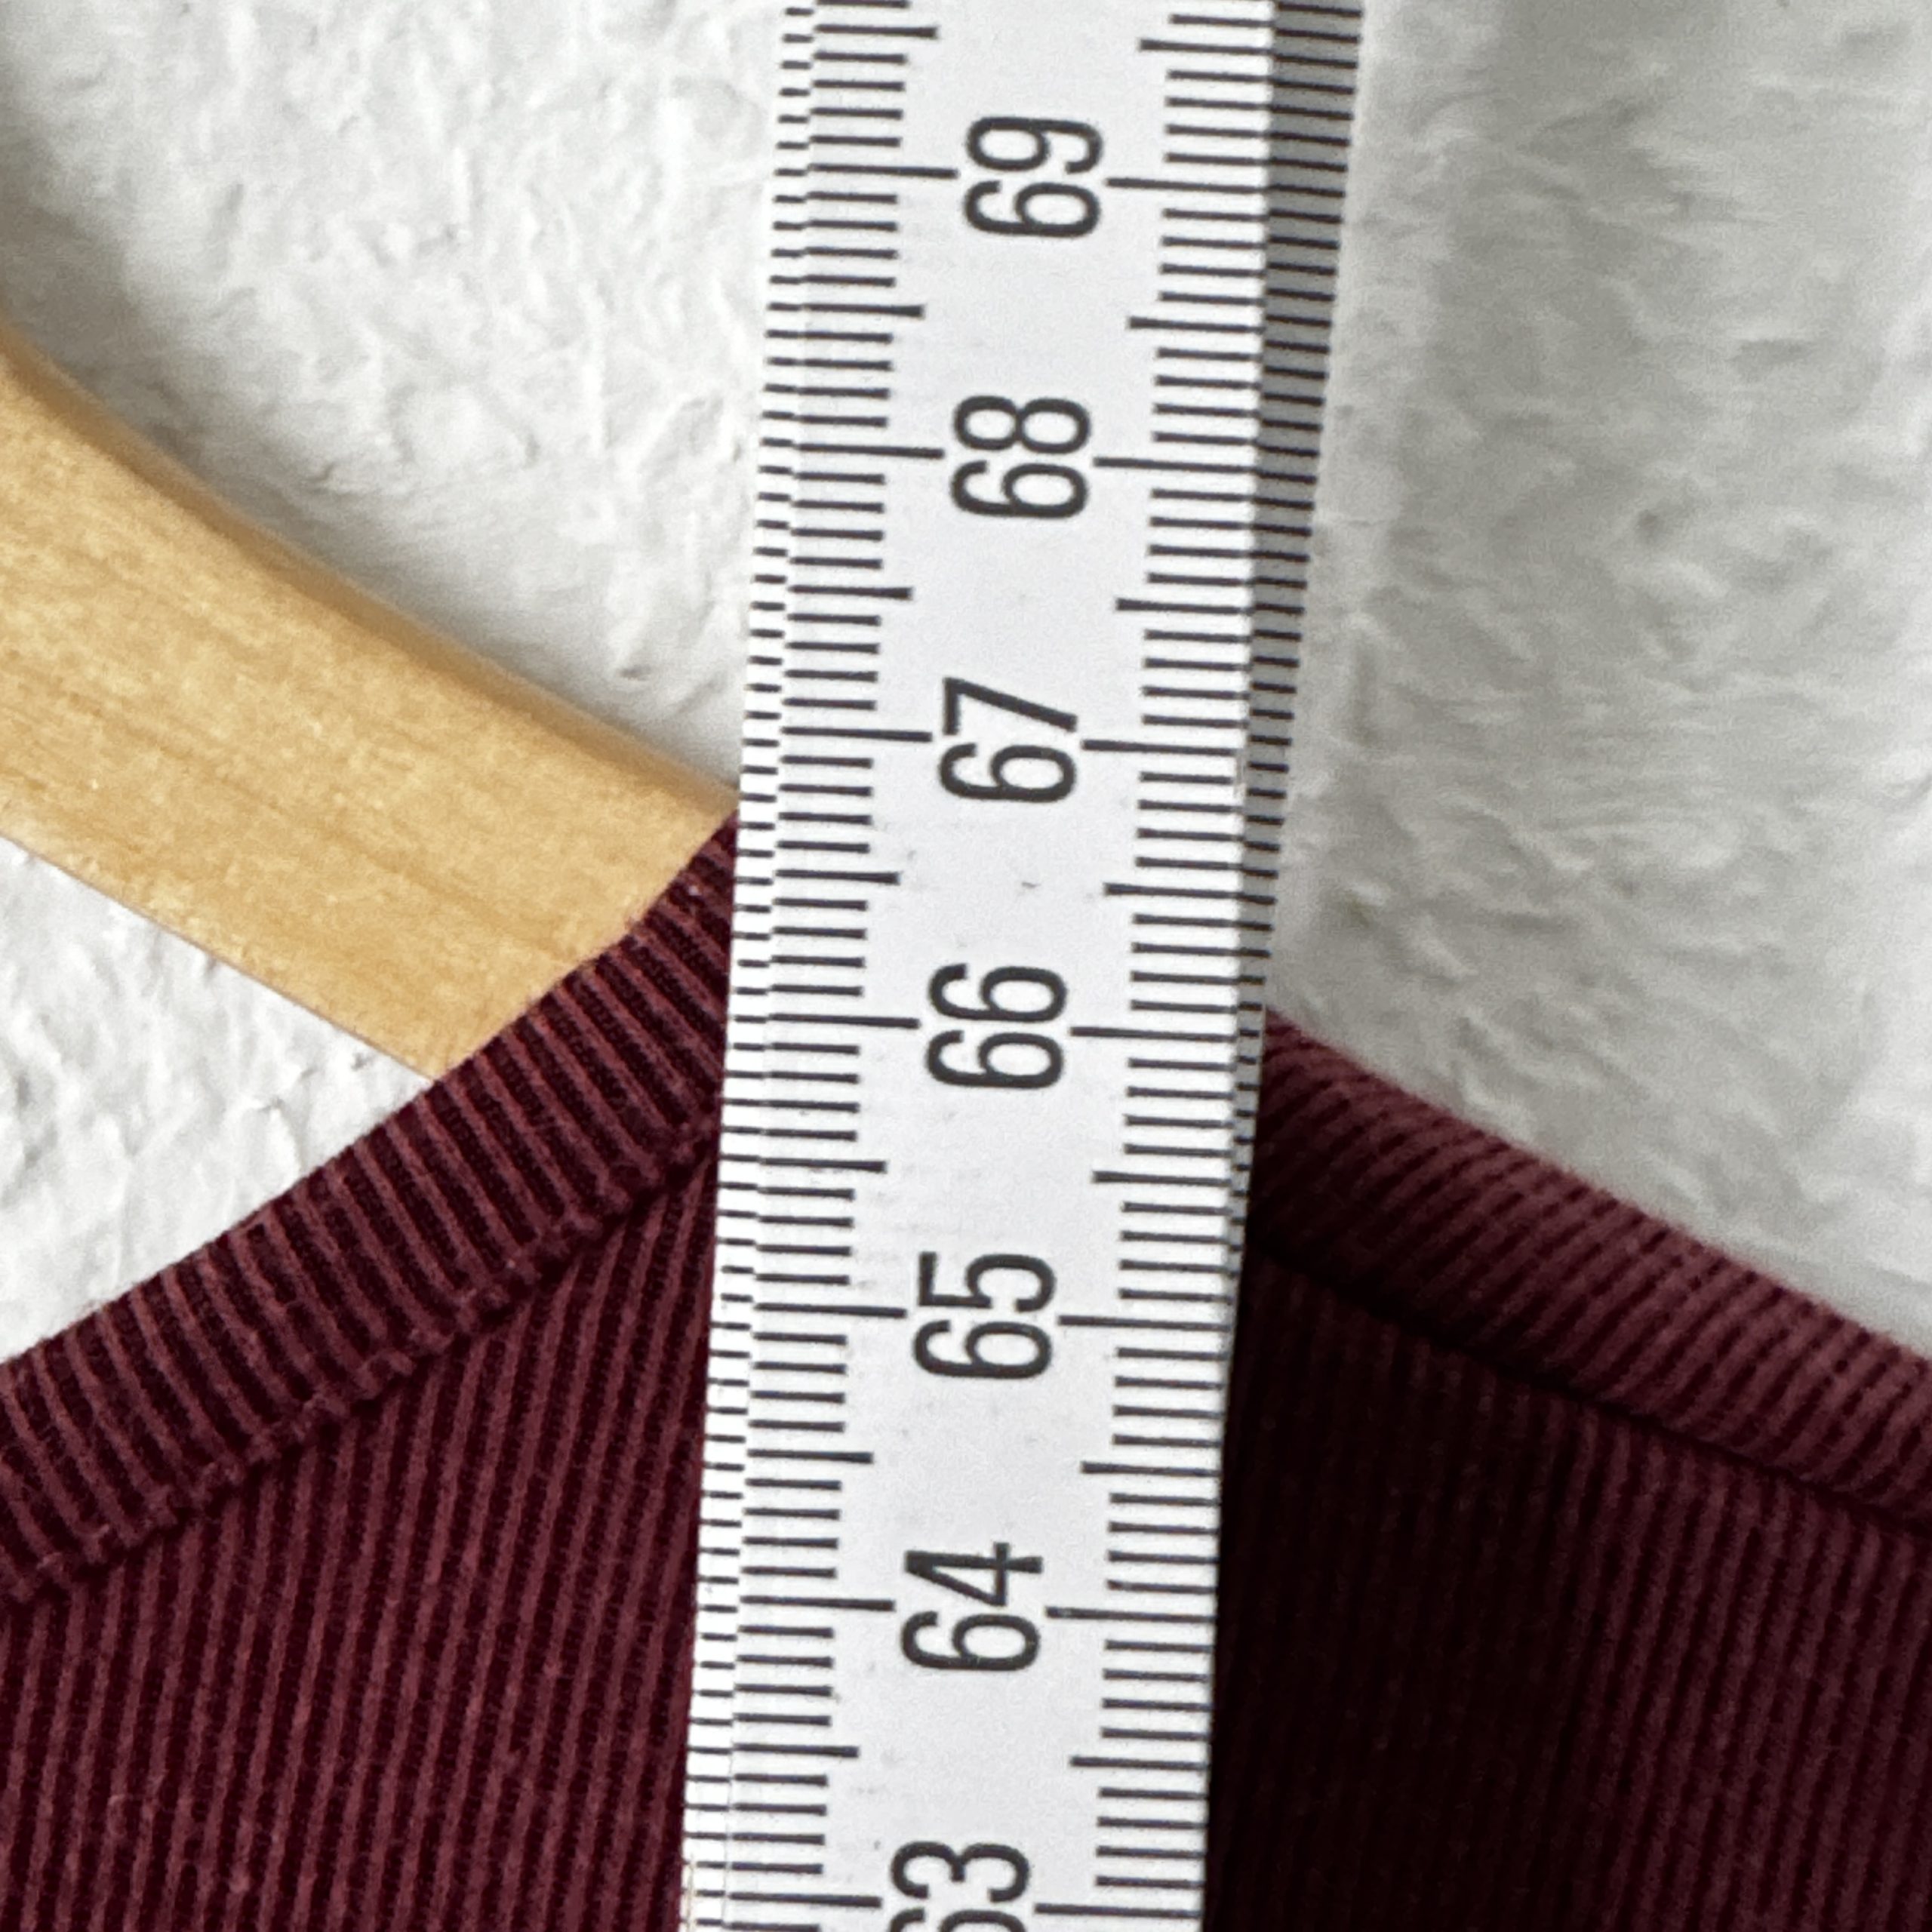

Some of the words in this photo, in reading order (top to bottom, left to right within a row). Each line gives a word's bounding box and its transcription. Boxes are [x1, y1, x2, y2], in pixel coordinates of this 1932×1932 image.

[964, 116, 1103, 239] 69
[952, 395, 1091, 520] 68
[940, 677, 1078, 804] 67
[927, 963, 1067, 1091] 66
[913, 1251, 1056, 1381] 65
[900, 1542, 1044, 1673] 64
